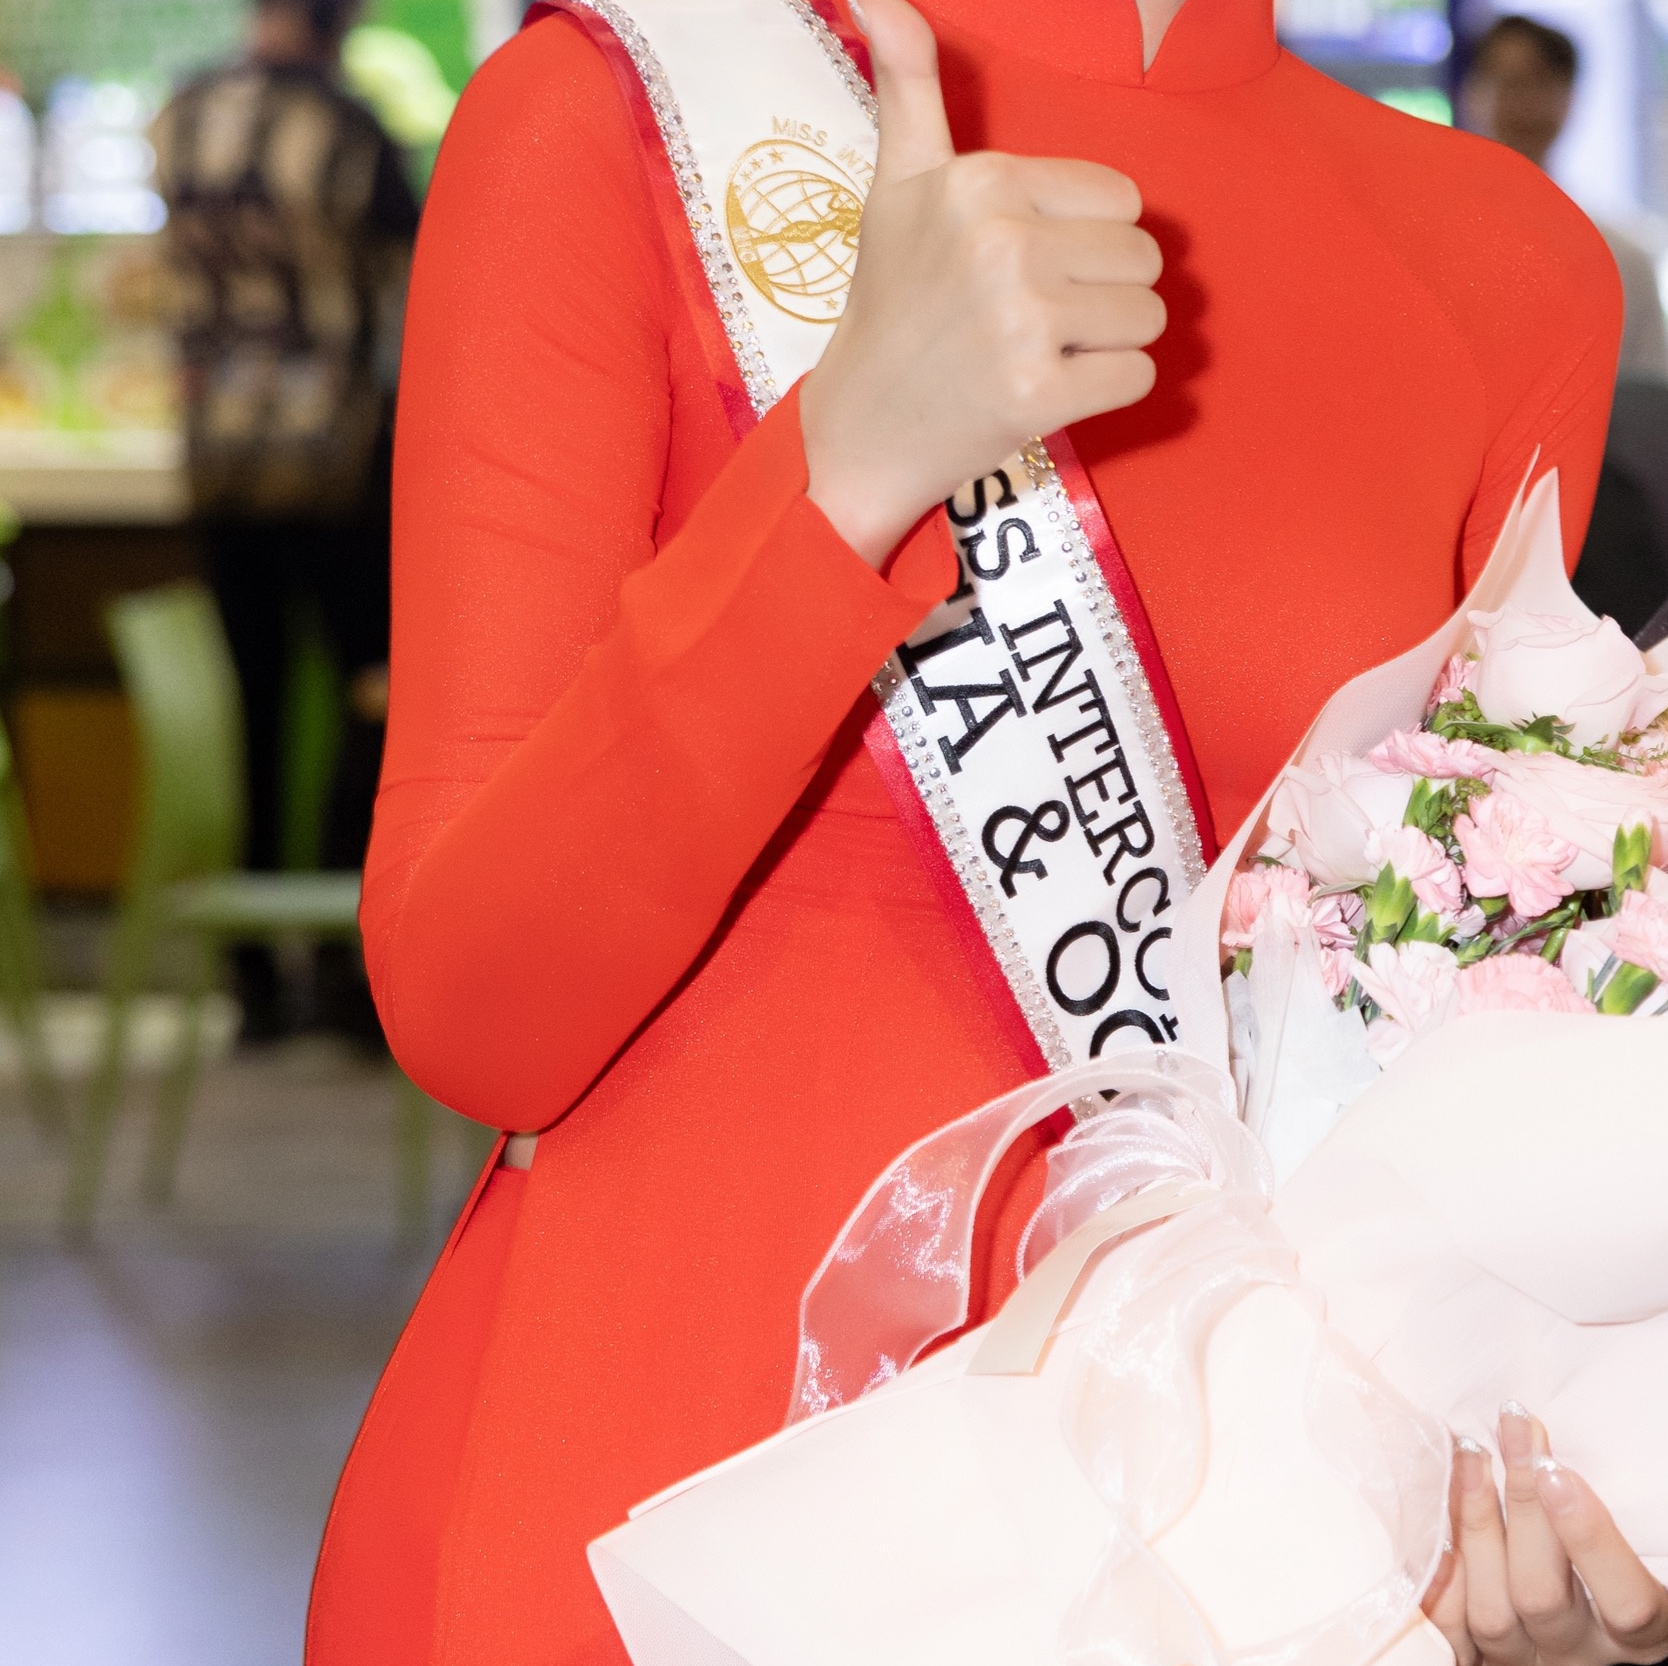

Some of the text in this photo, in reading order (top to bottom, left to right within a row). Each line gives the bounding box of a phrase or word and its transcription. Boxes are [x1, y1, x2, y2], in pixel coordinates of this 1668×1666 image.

[771, 115, 877, 189] MISS INT
[896, 551, 1028, 776] IA
[981, 799, 1071, 899] &
[999, 599, 1180, 1042] INTERCO
